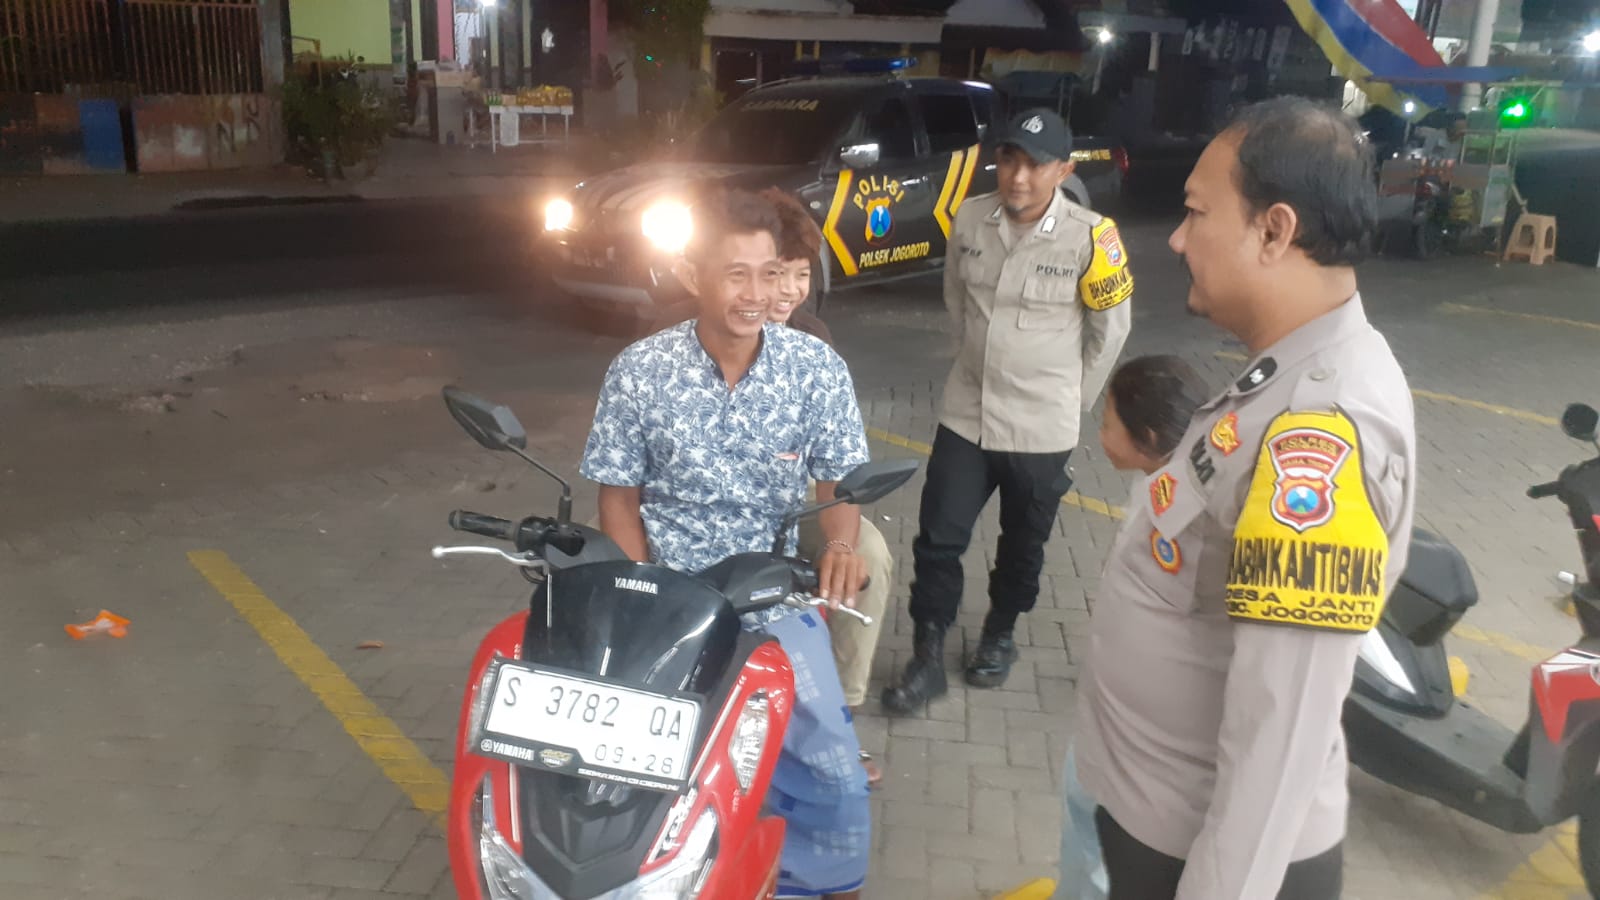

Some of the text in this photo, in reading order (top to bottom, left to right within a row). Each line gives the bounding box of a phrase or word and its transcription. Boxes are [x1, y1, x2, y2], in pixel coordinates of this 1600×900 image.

[853, 174, 905, 210] POLISI
[859, 241, 930, 268] POLSEK JOGOROTO
[1036, 264, 1076, 278] POLRI
[615, 577, 659, 595] YAMAHA
[1261, 604, 1374, 625] JOGOROTO
[1300, 597, 1376, 612] JANTI
[503, 676, 683, 741] S 3782 QA
[492, 741, 535, 761] YAMAHA
